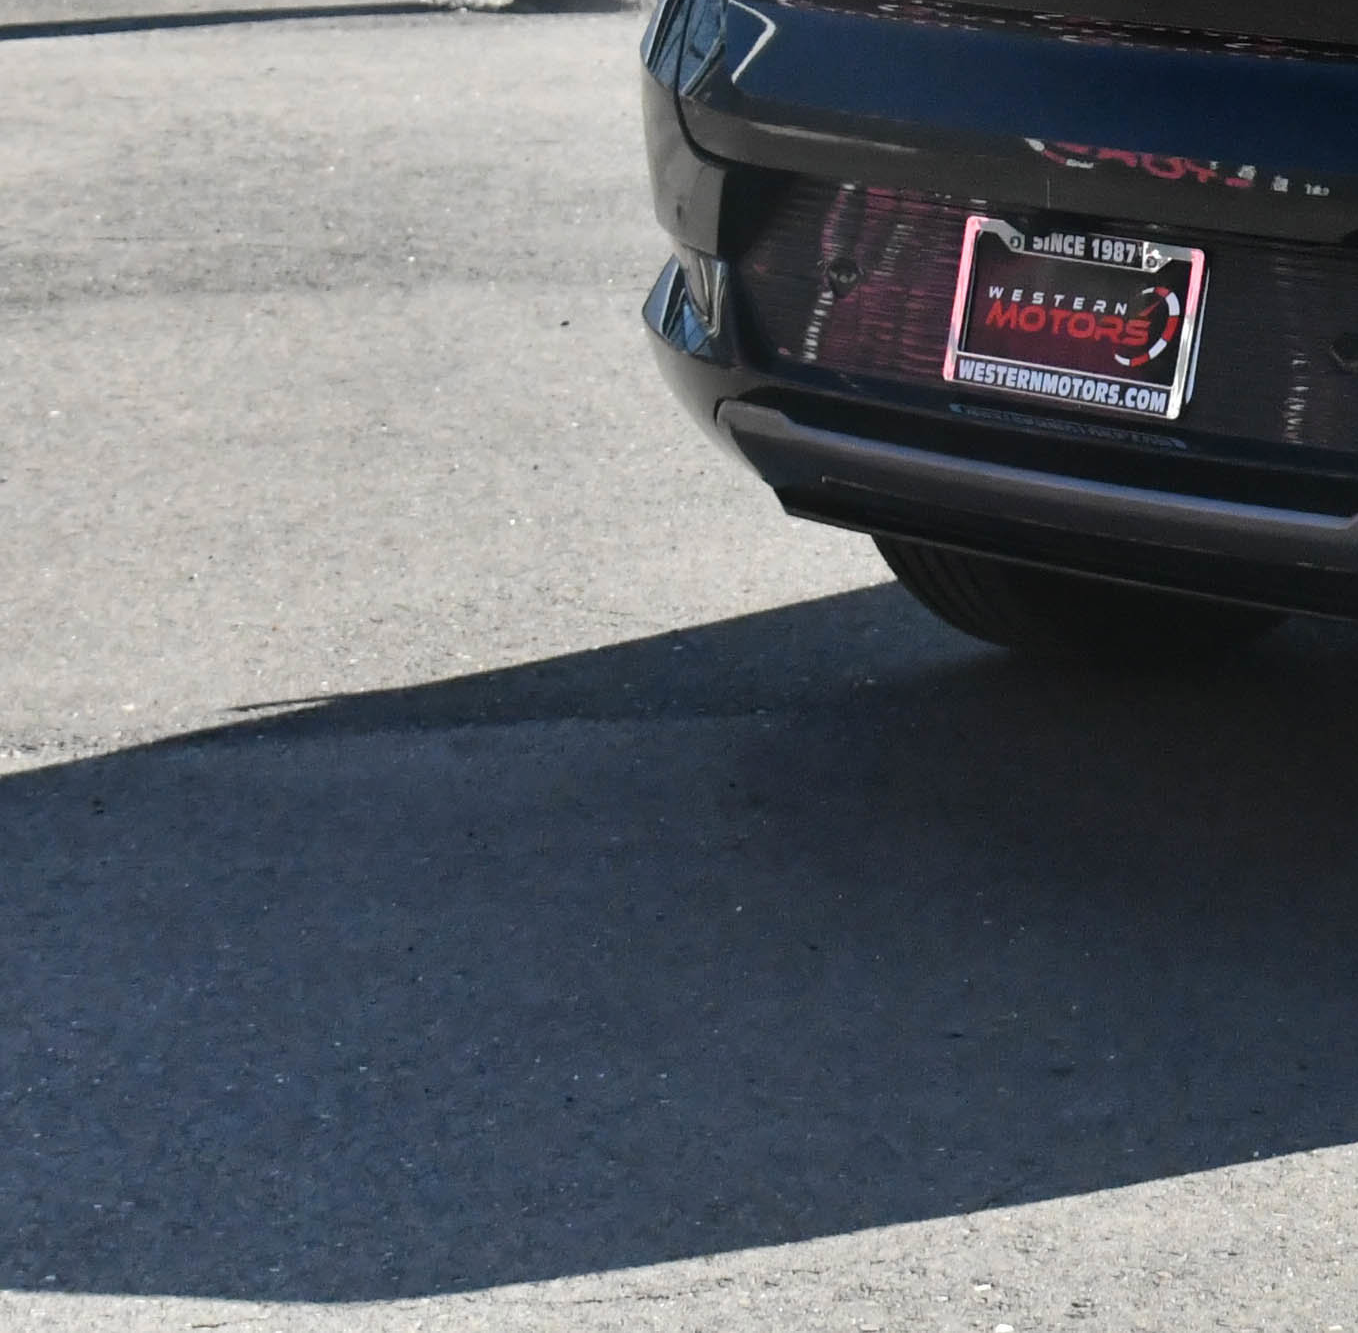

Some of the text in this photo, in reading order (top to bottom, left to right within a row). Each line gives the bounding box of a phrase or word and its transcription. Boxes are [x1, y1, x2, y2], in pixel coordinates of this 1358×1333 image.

[1033, 233, 1136, 263] SINCE 1987
[988, 285, 1128, 316] WESTERN
[985, 300, 1151, 347] MOTORS
[958, 359, 1167, 414] WESTERNMOTORS.COM
